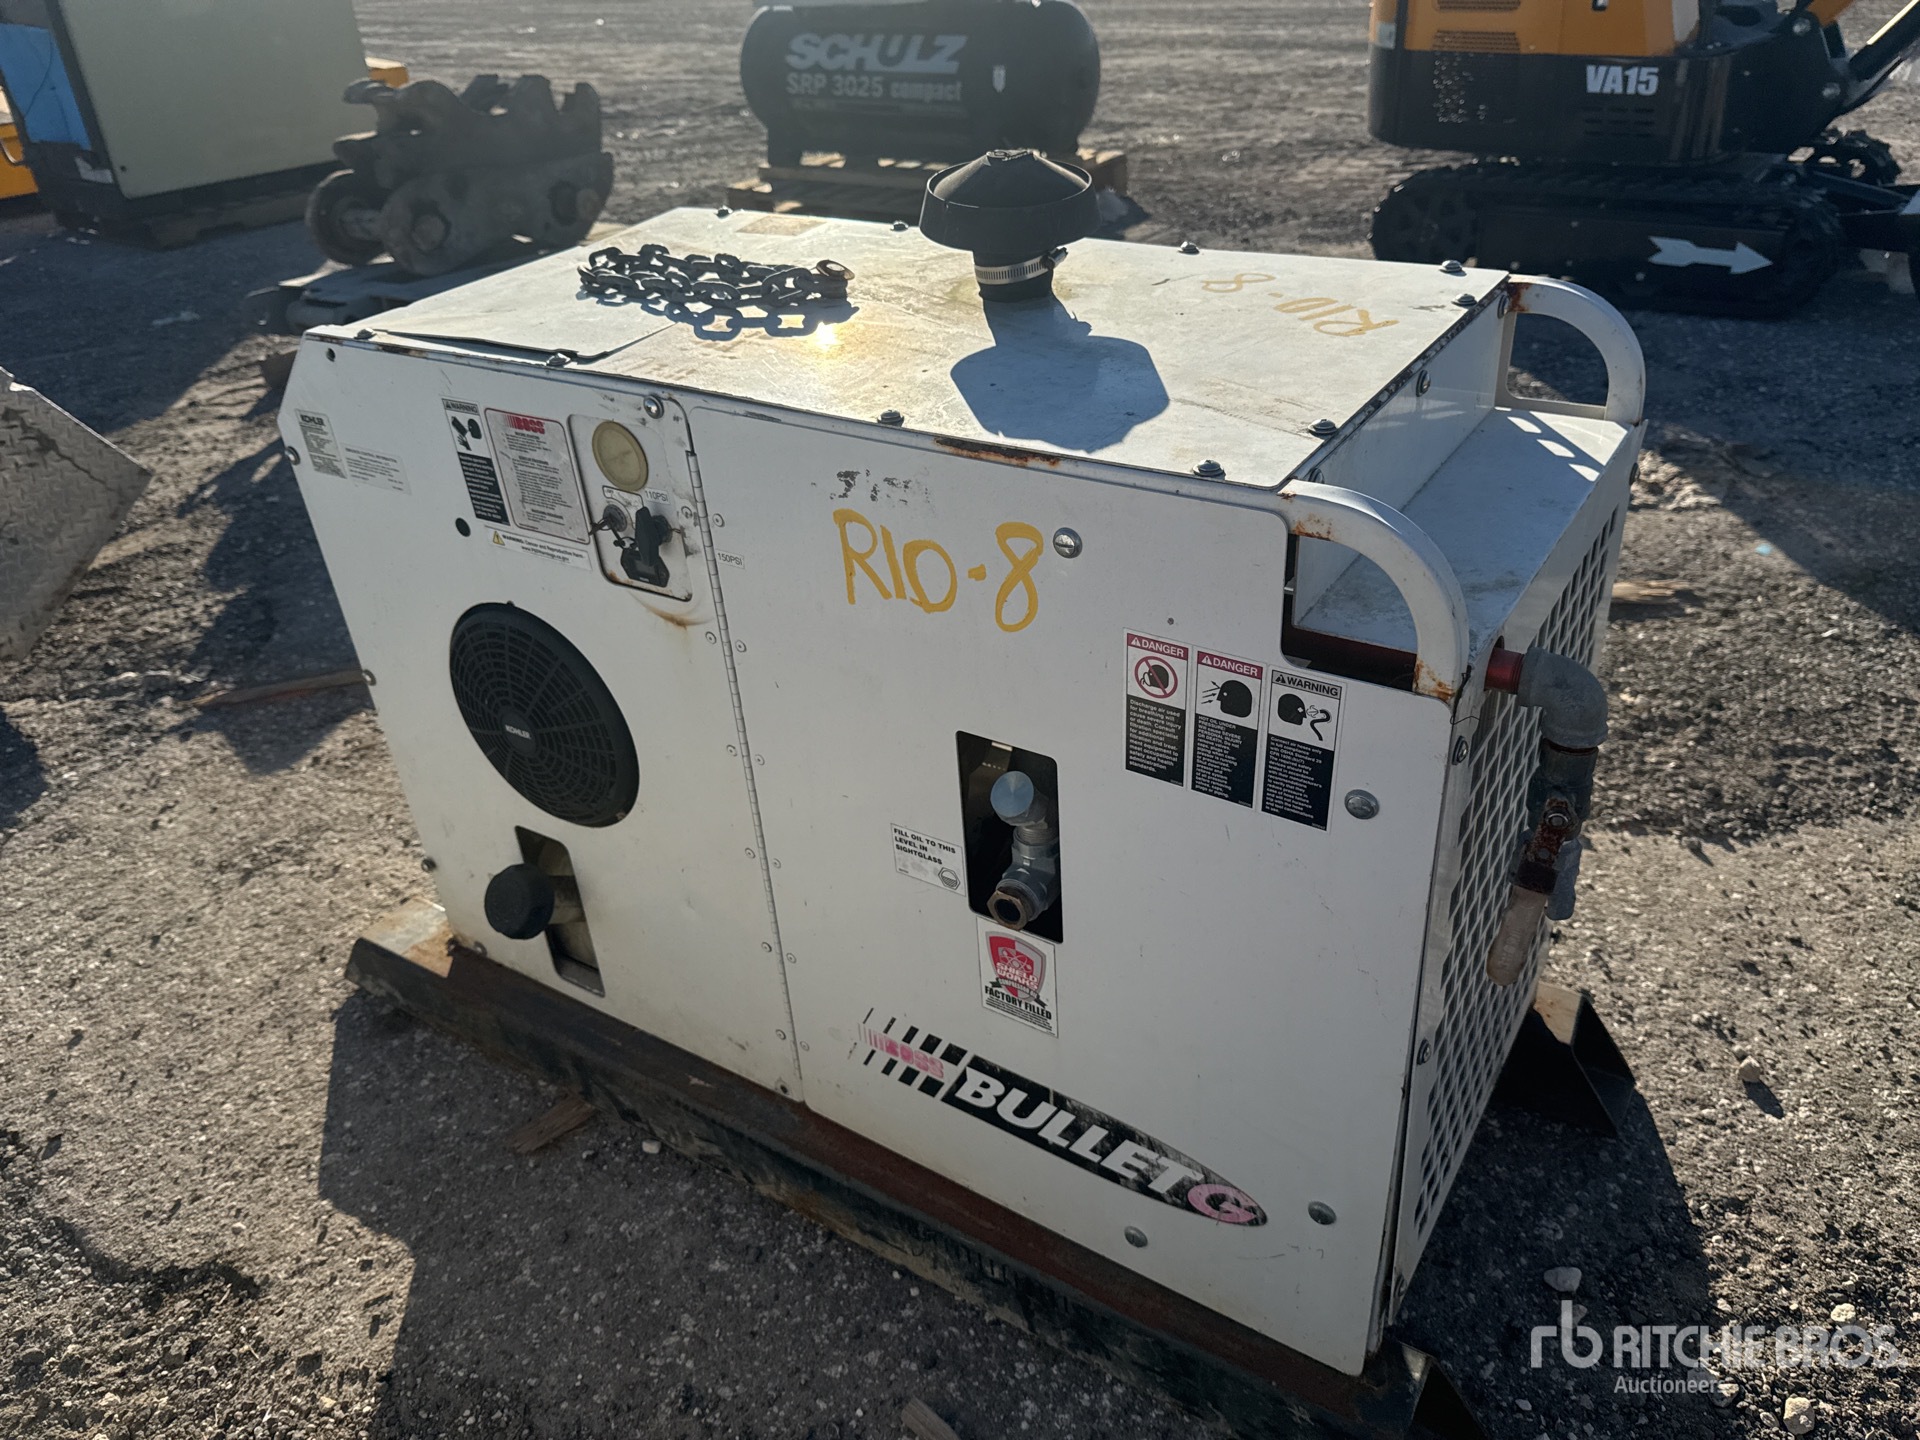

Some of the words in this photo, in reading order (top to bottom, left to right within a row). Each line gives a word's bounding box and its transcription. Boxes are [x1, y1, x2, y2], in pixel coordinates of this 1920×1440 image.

[785, 33, 968, 74] SCHULZ
[785, 73, 827, 95] SRP
[831, 74, 884, 98] 3025
[890, 81, 962, 103] compact
[1586, 65, 1659, 96] VA15
[450, 403, 477, 413] WARNING
[300, 414, 325, 426] KOHLER
[645, 490, 668, 502] 110PSI
[718, 553, 742, 565] 150PSI
[1142, 639, 1184, 657] DANGER
[1213, 658, 1258, 676] DANGER
[1287, 676, 1338, 696] WARNING
[506, 725, 531, 739] KOHLER
[894, 828, 909, 838] FILL
[911, 834, 923, 843] OIL
[925, 839, 936, 847] TO
[938, 843, 955, 853] THIS
[895, 836, 918, 848] LEVEL
[919, 844, 927, 852] IN
[896, 844, 942, 865] SIGHTGLASS
[996, 962, 1038, 983] SHIELD
[997, 968, 1039, 990] WORKS
[985, 985, 1022, 1008] FACTORY
[1025, 1001, 1051, 1020] FILLED
[878, 1031, 944, 1078] BOSS
[954, 1066, 1204, 1193] BULLET
